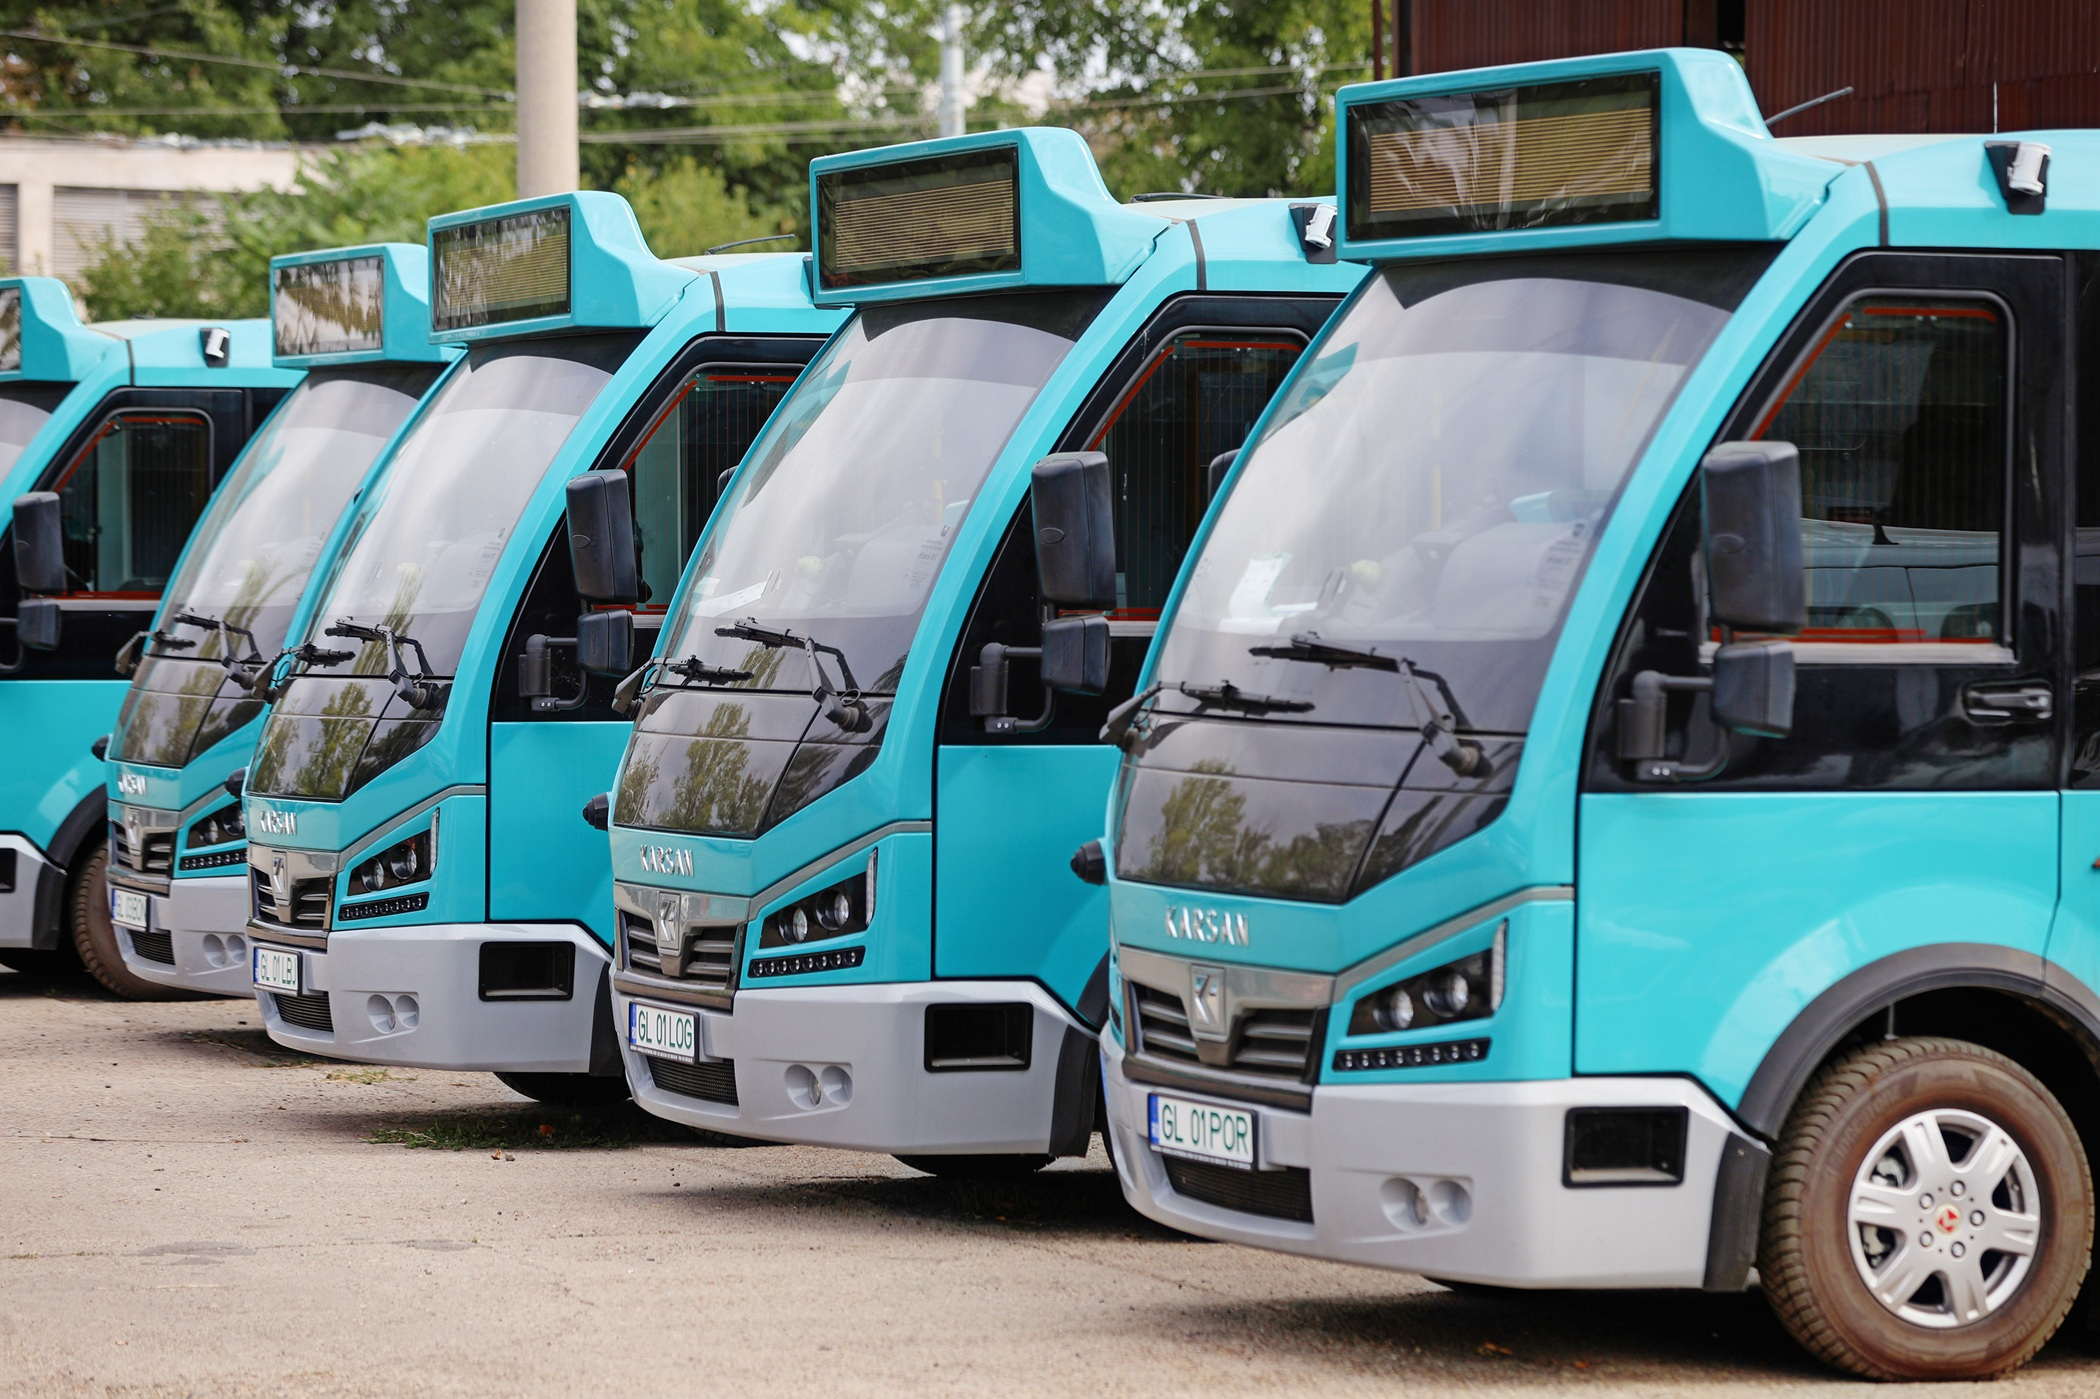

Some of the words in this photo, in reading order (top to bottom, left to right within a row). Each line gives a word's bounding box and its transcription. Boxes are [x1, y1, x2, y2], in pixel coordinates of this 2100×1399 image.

[261, 810, 297, 836] KARSAN
[640, 844, 694, 877] KARSAN
[1165, 905, 1249, 947] KARSAN
[261, 953, 270, 981] GL
[638, 1010, 653, 1043] GL
[1162, 1104, 1184, 1143] GL
